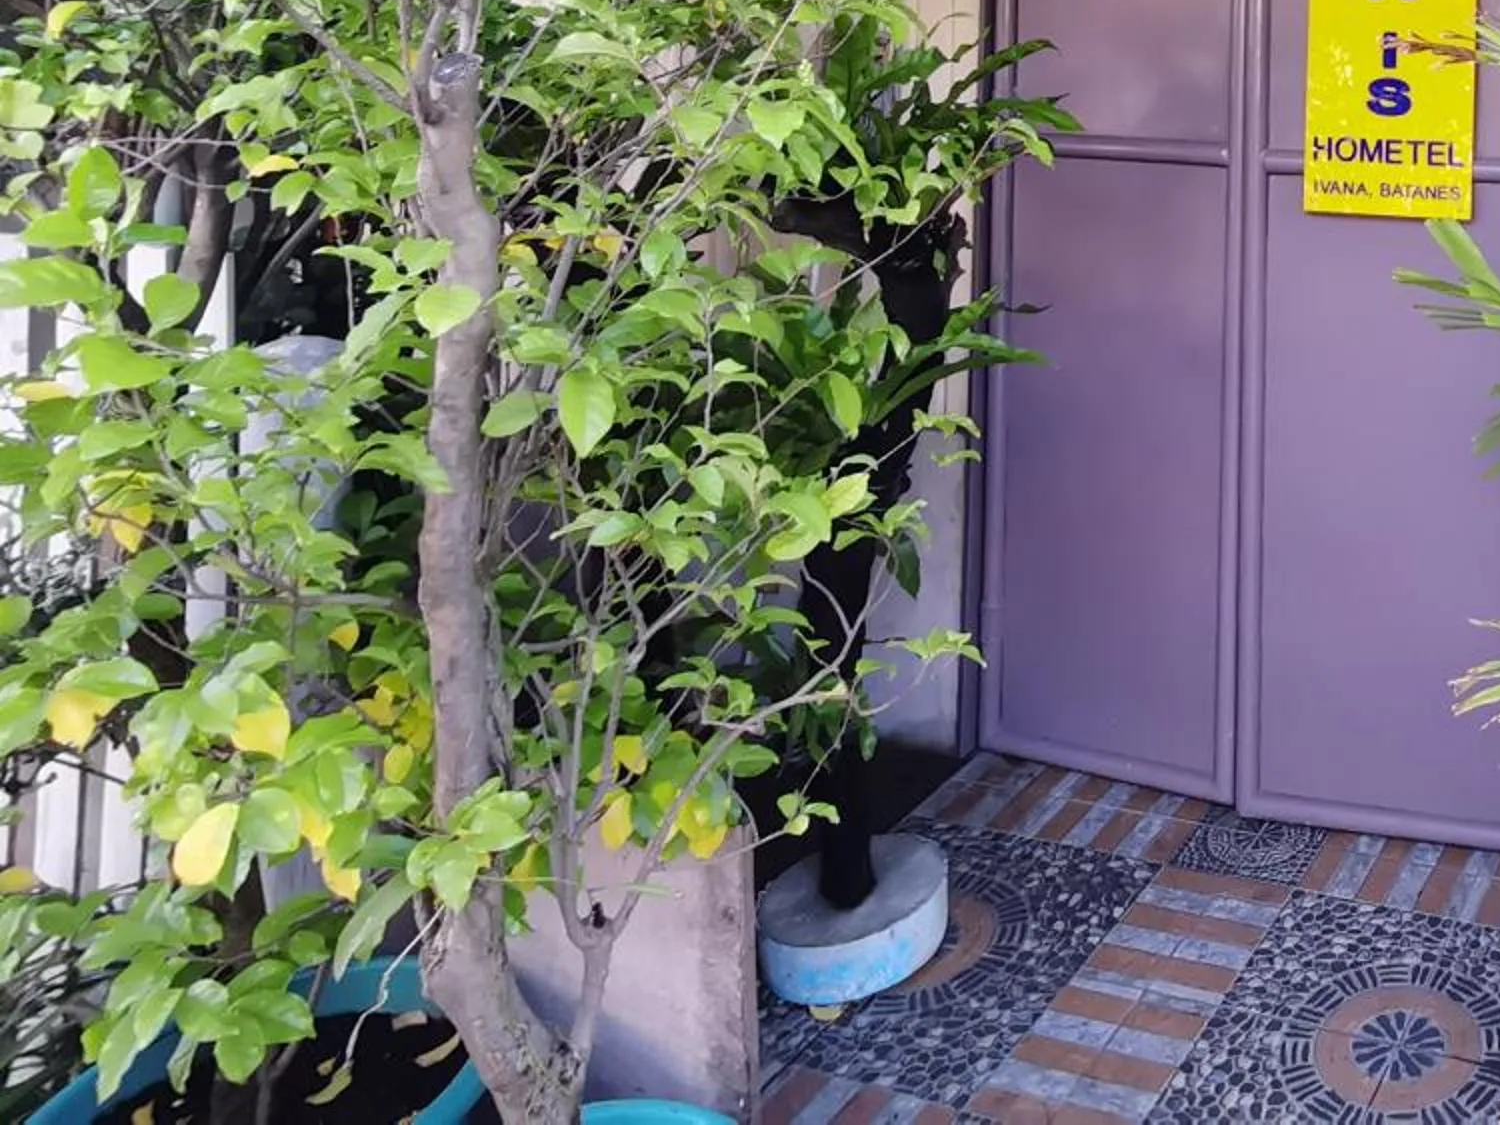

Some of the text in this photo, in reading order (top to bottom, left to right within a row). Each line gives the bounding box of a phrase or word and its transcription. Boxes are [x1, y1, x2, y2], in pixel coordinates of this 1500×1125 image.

[1366, 32, 1412, 116] IS
[1313, 137, 1464, 168] HOMETEL
[1313, 179, 1461, 201] IVANA, BATANES
